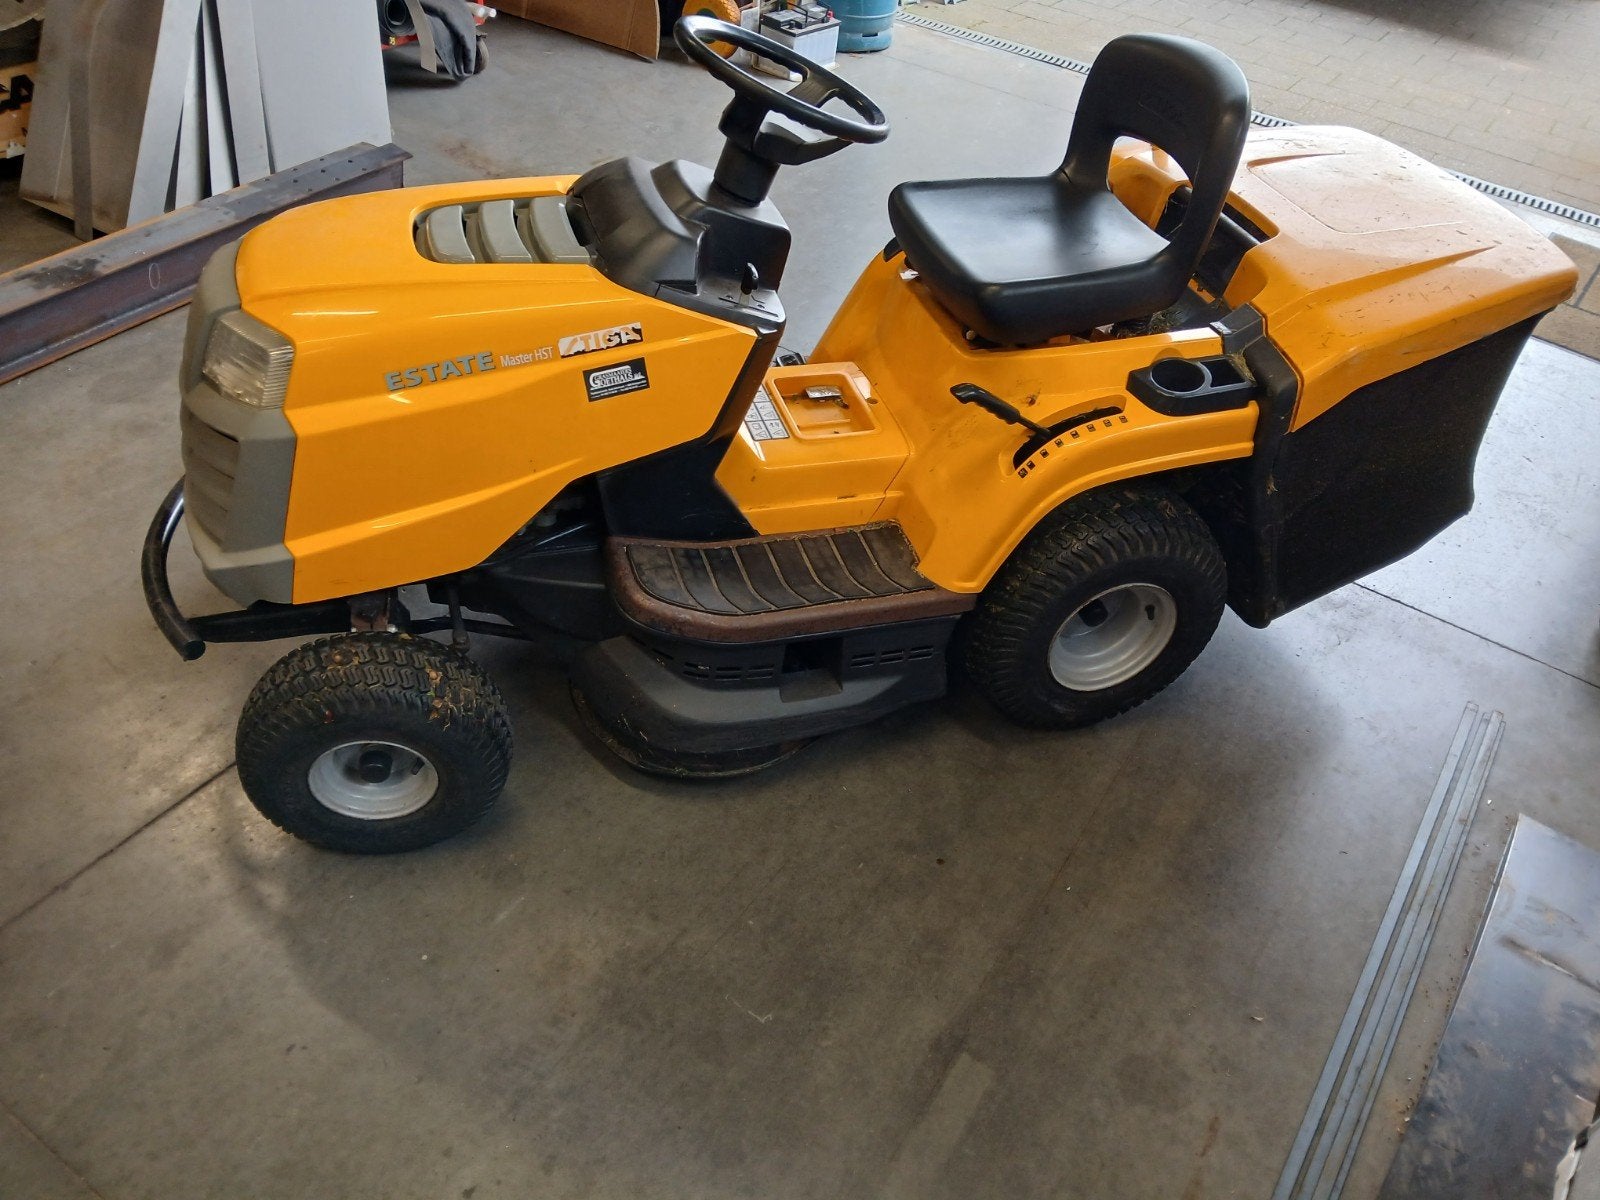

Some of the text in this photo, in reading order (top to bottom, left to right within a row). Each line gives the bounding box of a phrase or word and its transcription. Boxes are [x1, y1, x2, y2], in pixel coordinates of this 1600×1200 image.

[384, 347, 553, 391] ESTATE Master HST
